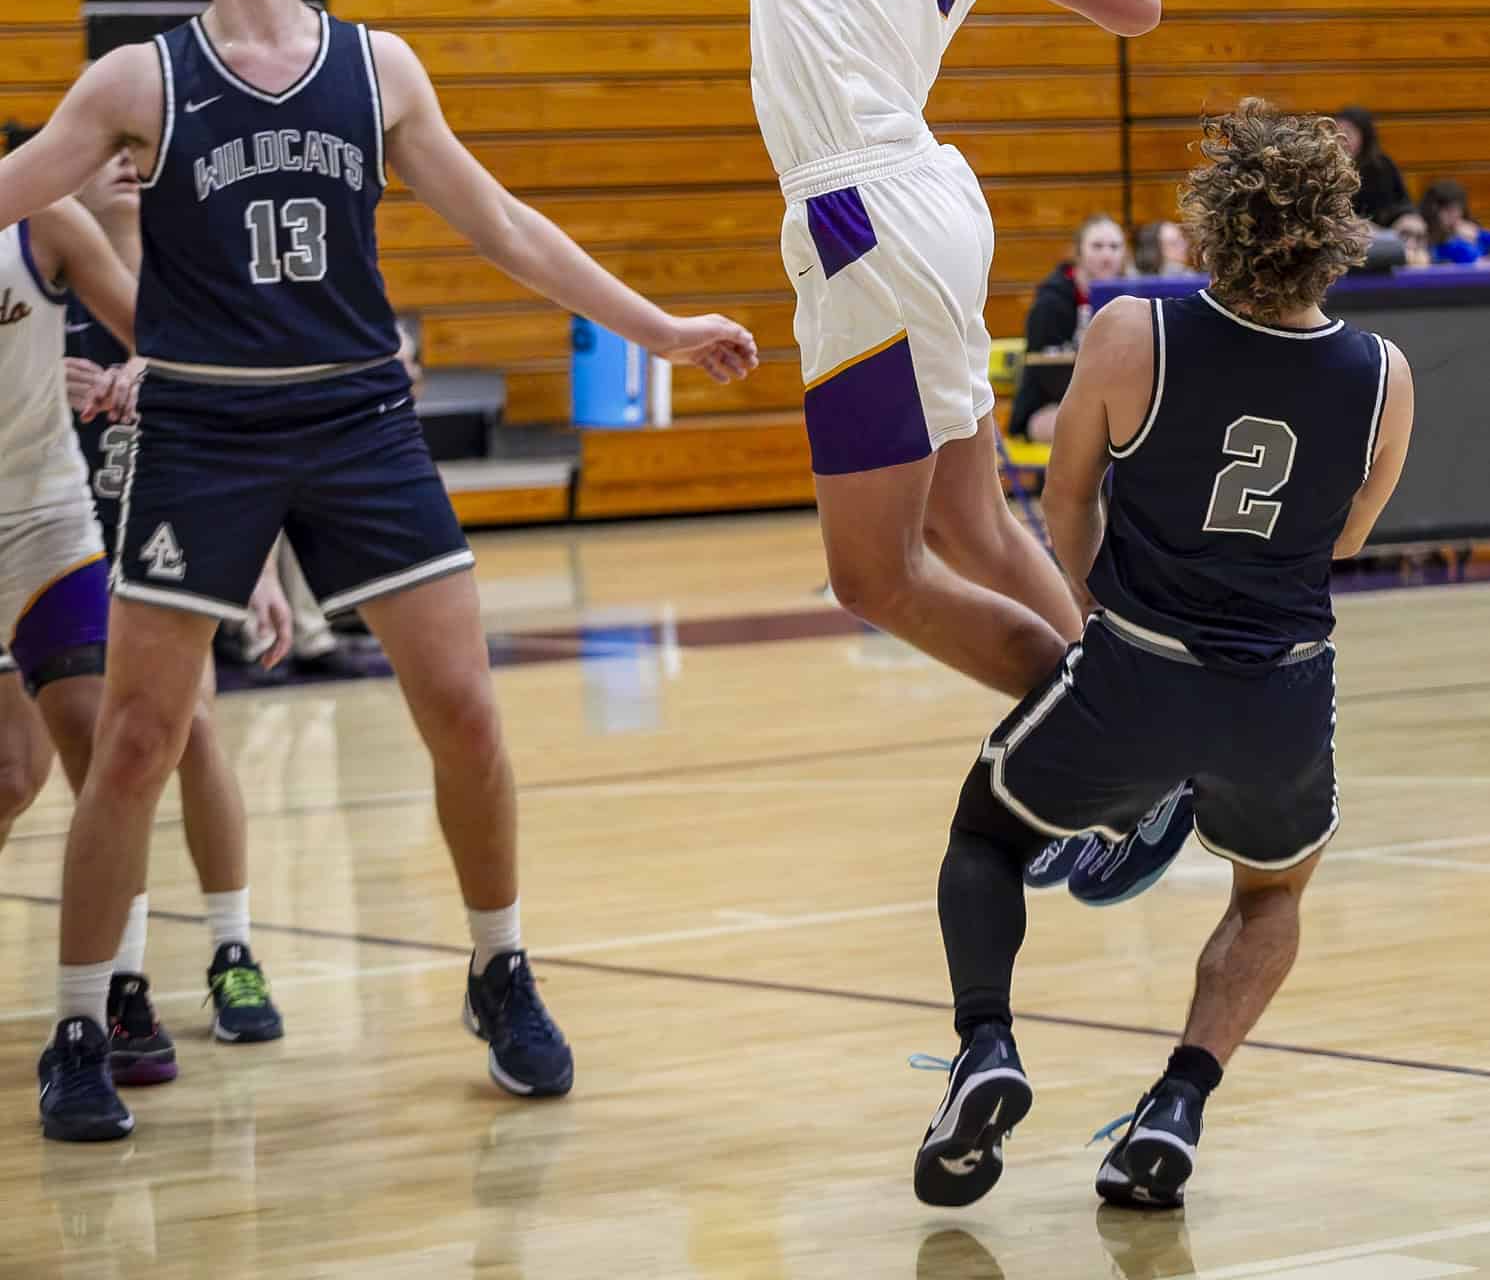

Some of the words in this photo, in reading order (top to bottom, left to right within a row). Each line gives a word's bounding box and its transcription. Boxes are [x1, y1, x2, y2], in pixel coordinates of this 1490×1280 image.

[193, 129, 364, 202] WILDCATS
[244, 197, 328, 285] 13
[1202, 415, 1298, 540] 2
